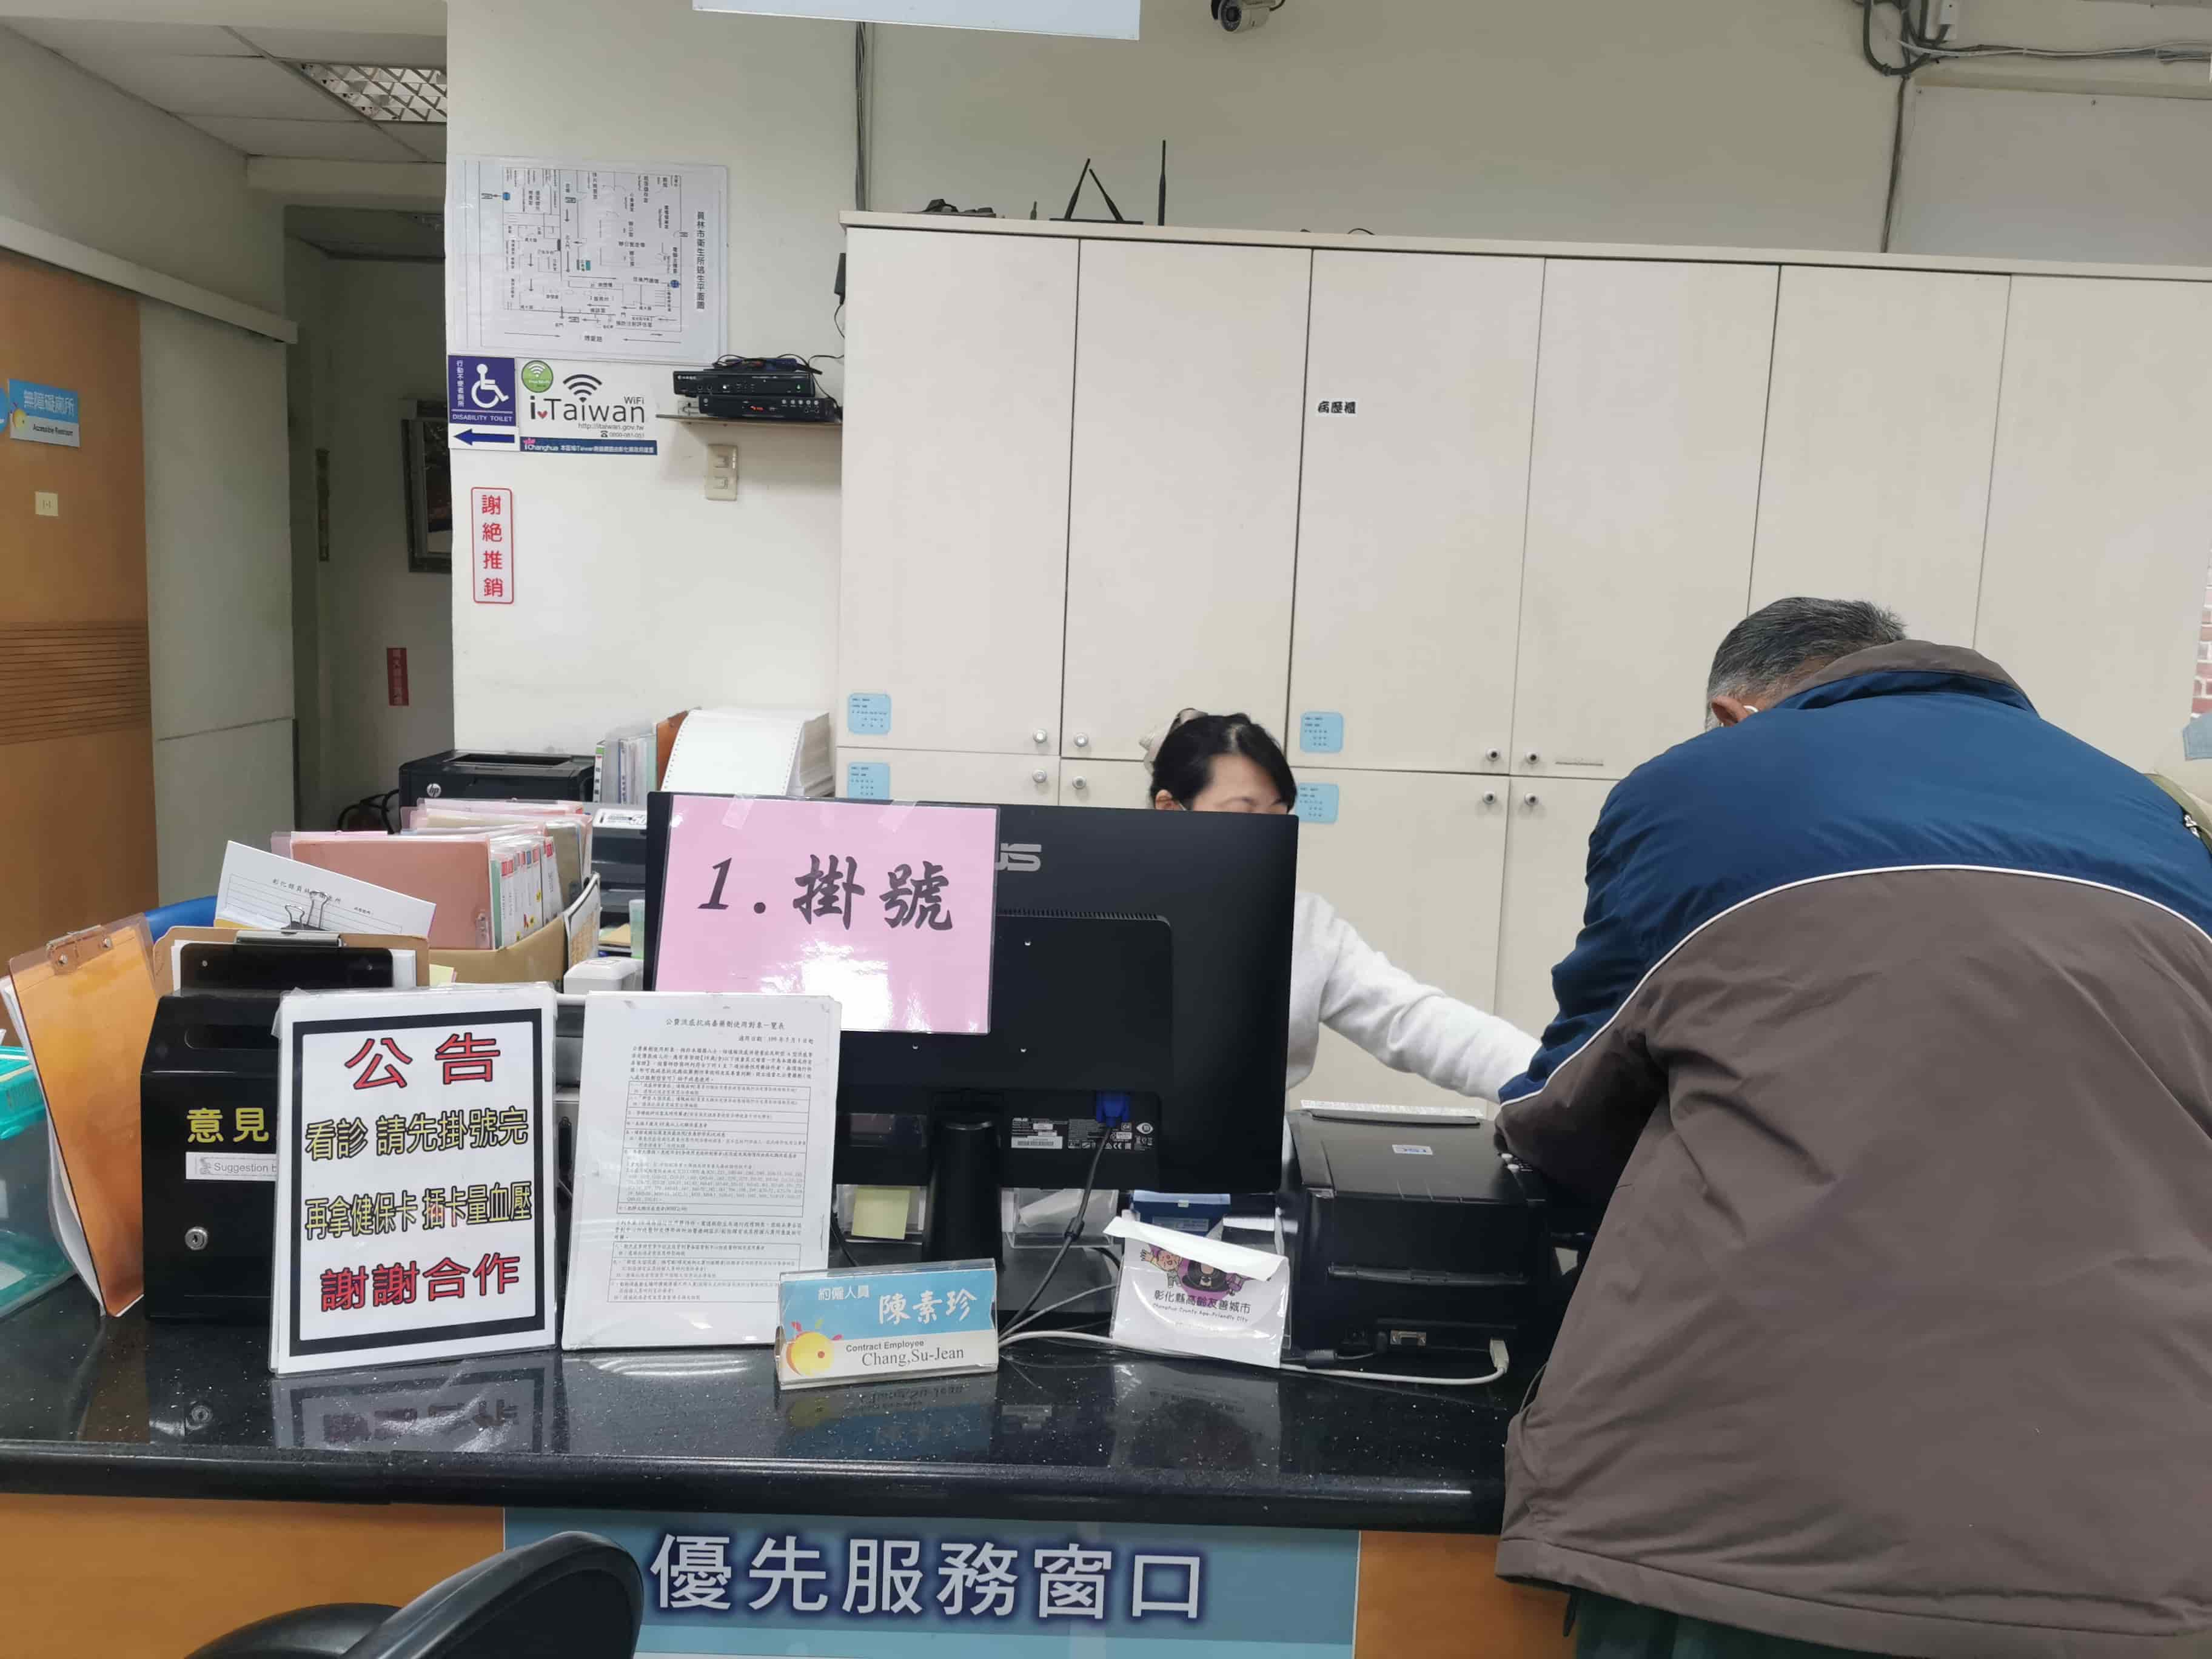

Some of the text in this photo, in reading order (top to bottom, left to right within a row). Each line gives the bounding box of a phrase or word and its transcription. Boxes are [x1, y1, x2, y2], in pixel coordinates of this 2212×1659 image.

[452, 414, 488, 422] DISABILITY
[623, 396, 645, 405] WiFi
[344, 1033, 501, 1090] 公告
[187, 1107, 269, 1142] 意見
[305, 1105, 528, 1161] 看診 請先掛號完
[213, 1162, 269, 1174] Suggestion
[305, 1190, 418, 1240] 再拿健保卡
[320, 1252, 520, 1312] 謝謝合作
[879, 1289, 977, 1326] 陳素珍
[846, 1339, 925, 1352] Contract Employee
[862, 1347, 965, 1367] Chang,Su-Jean
[649, 1533, 1201, 1620] 優先服務窗口
